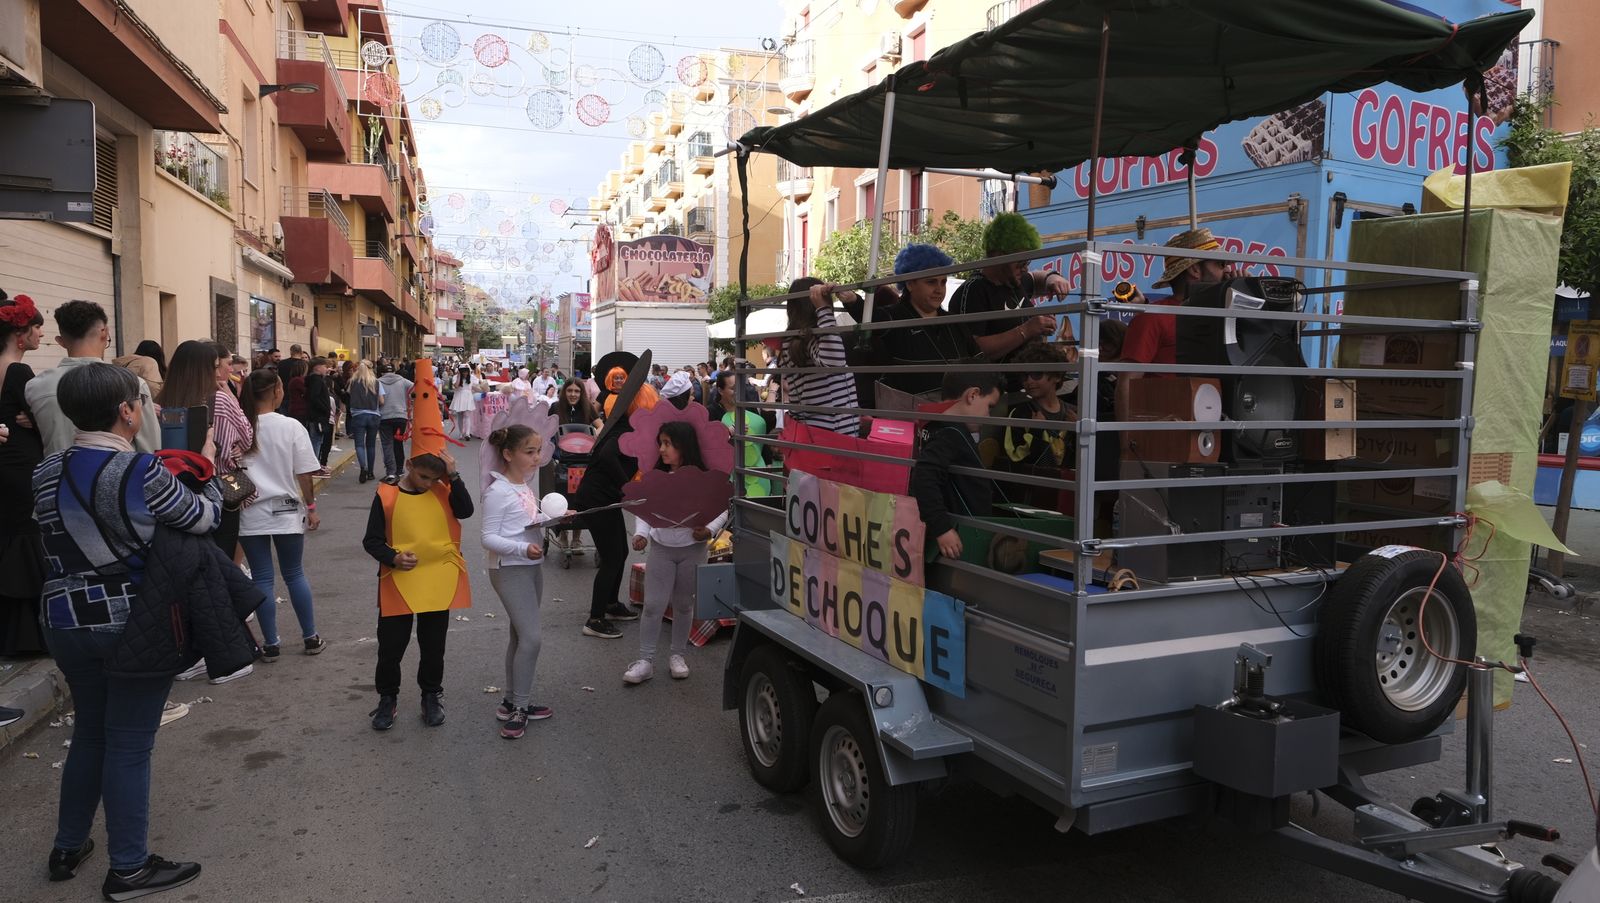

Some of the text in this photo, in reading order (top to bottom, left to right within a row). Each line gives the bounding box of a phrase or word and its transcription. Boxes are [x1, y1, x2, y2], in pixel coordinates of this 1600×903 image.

[1352, 88, 1496, 176] GOFRES
[620, 245, 711, 264] CHOCOLATERÍA
[788, 494, 913, 579] COCHES
[1014, 645, 1059, 669] REMOLQUES
